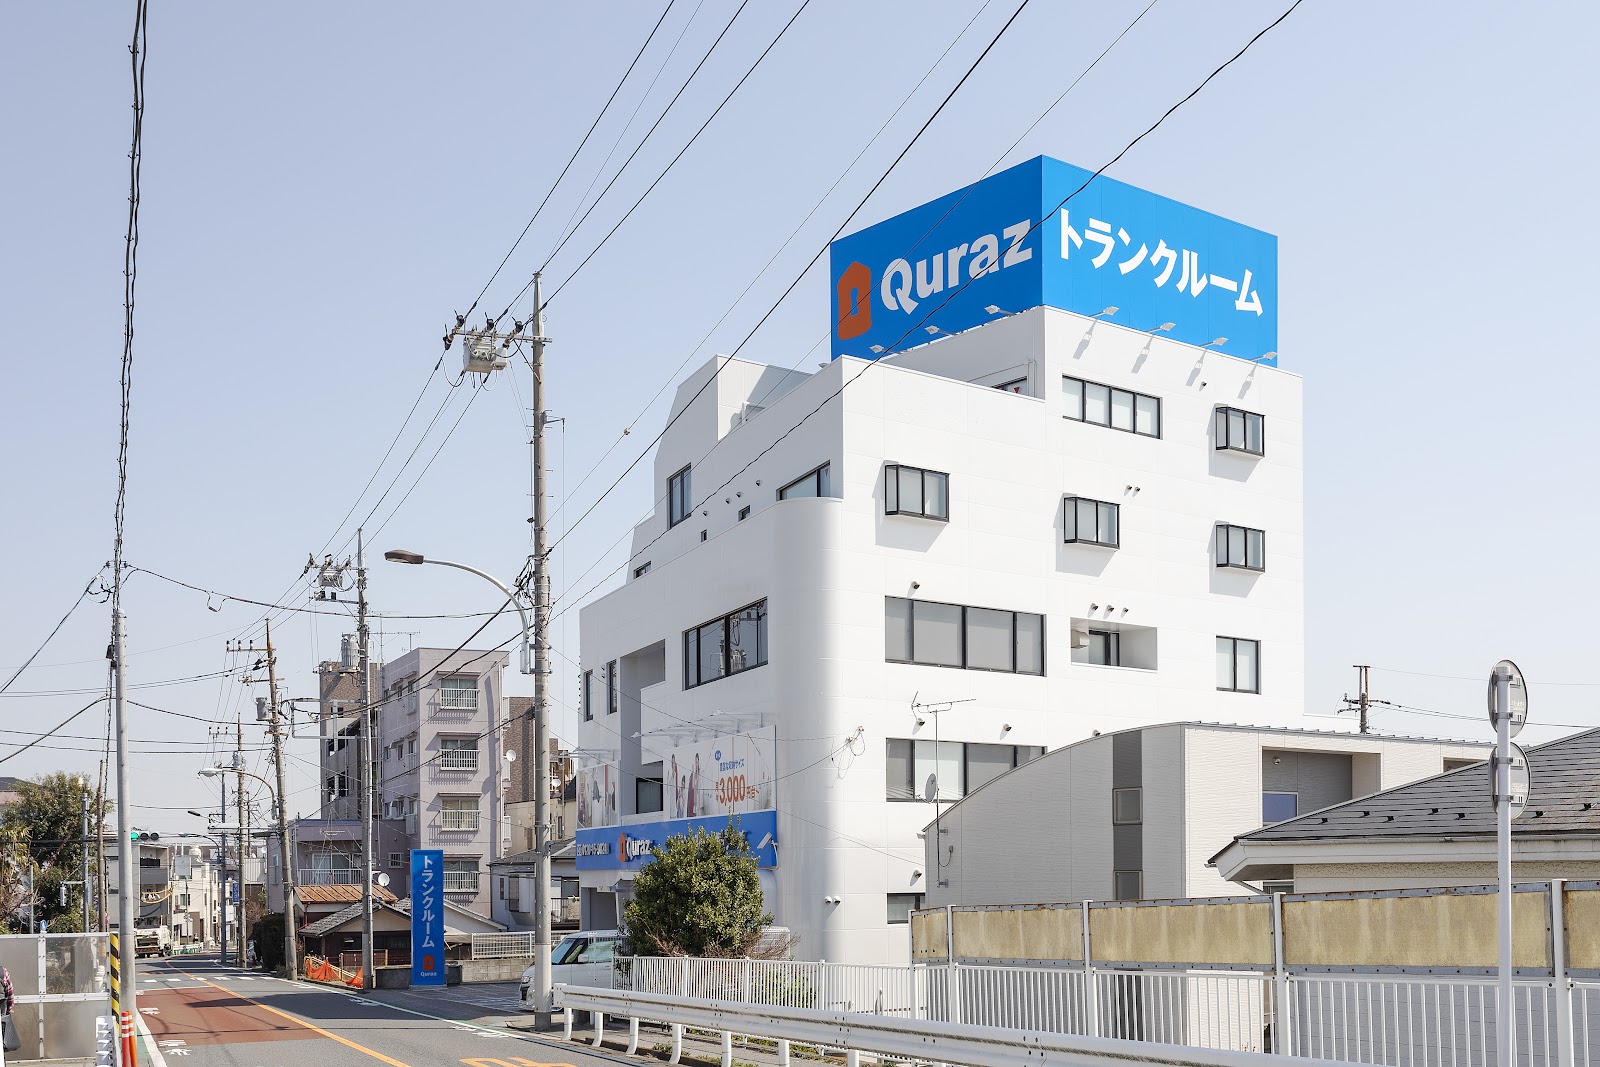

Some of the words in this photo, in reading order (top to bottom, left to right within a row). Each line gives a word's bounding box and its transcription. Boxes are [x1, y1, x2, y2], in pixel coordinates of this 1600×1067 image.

[880, 218, 1033, 315] Quraz
[1060, 207, 1264, 317] トランクルーム
[626, 836, 653, 860] Quraz
[421, 855, 435, 948] トランクルーム
